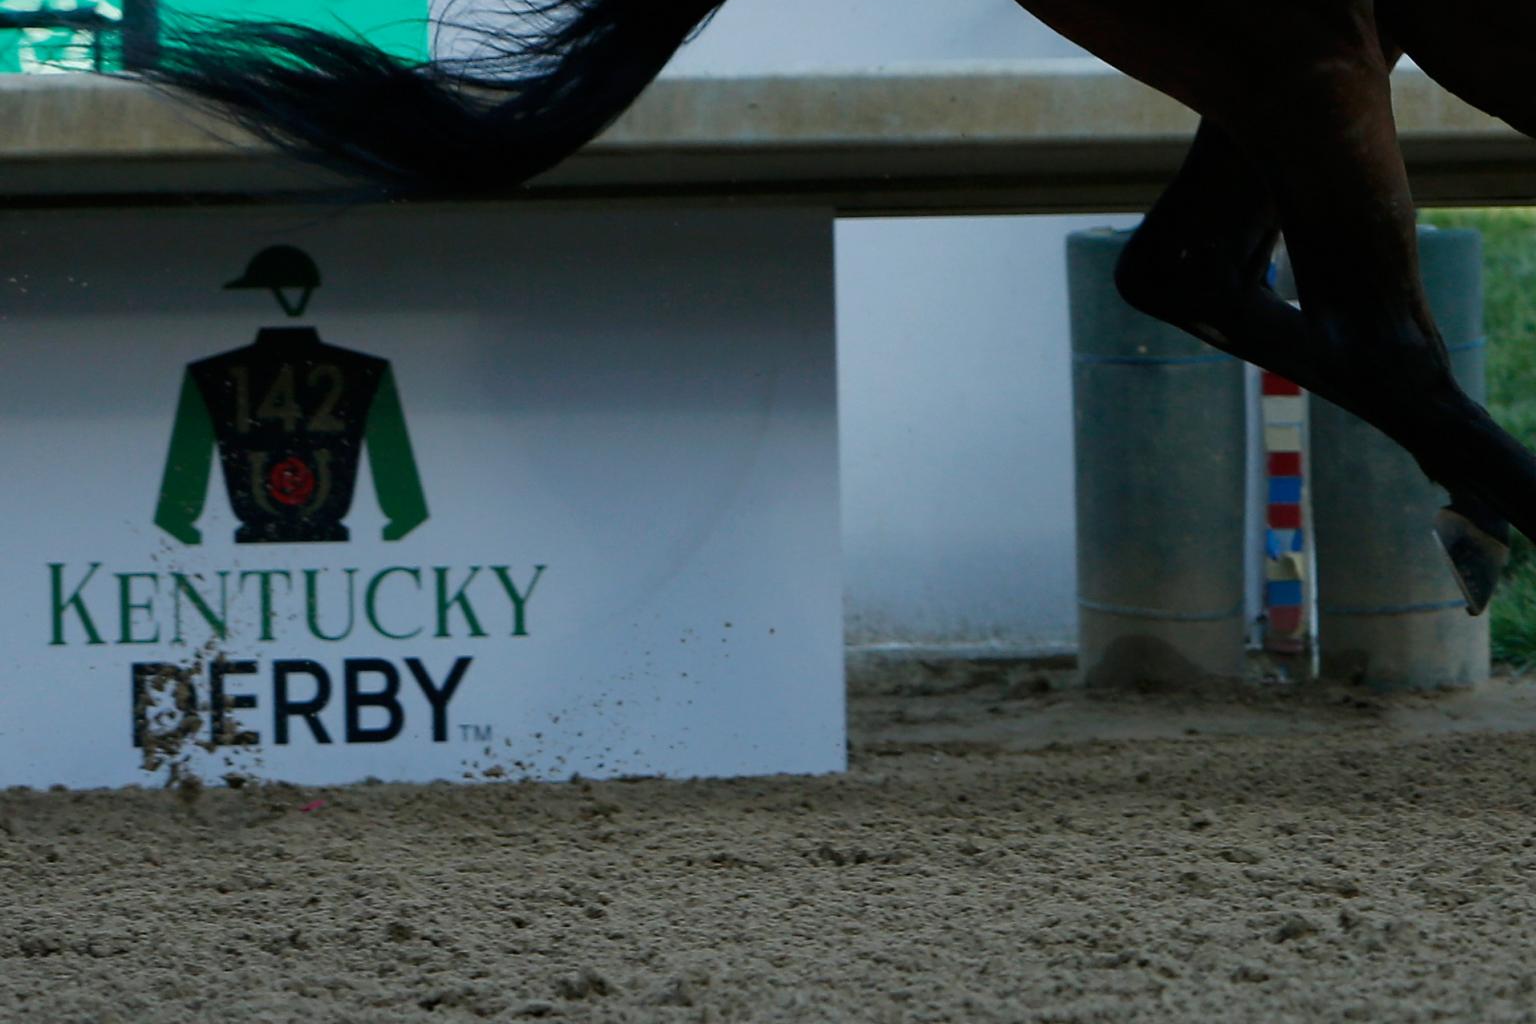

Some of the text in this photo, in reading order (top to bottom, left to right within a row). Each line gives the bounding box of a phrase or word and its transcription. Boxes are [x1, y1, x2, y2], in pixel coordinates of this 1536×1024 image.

[229, 362, 346, 433] 142
[48, 562, 548, 645] KENTUCKY
[131, 656, 474, 748] DERBY
